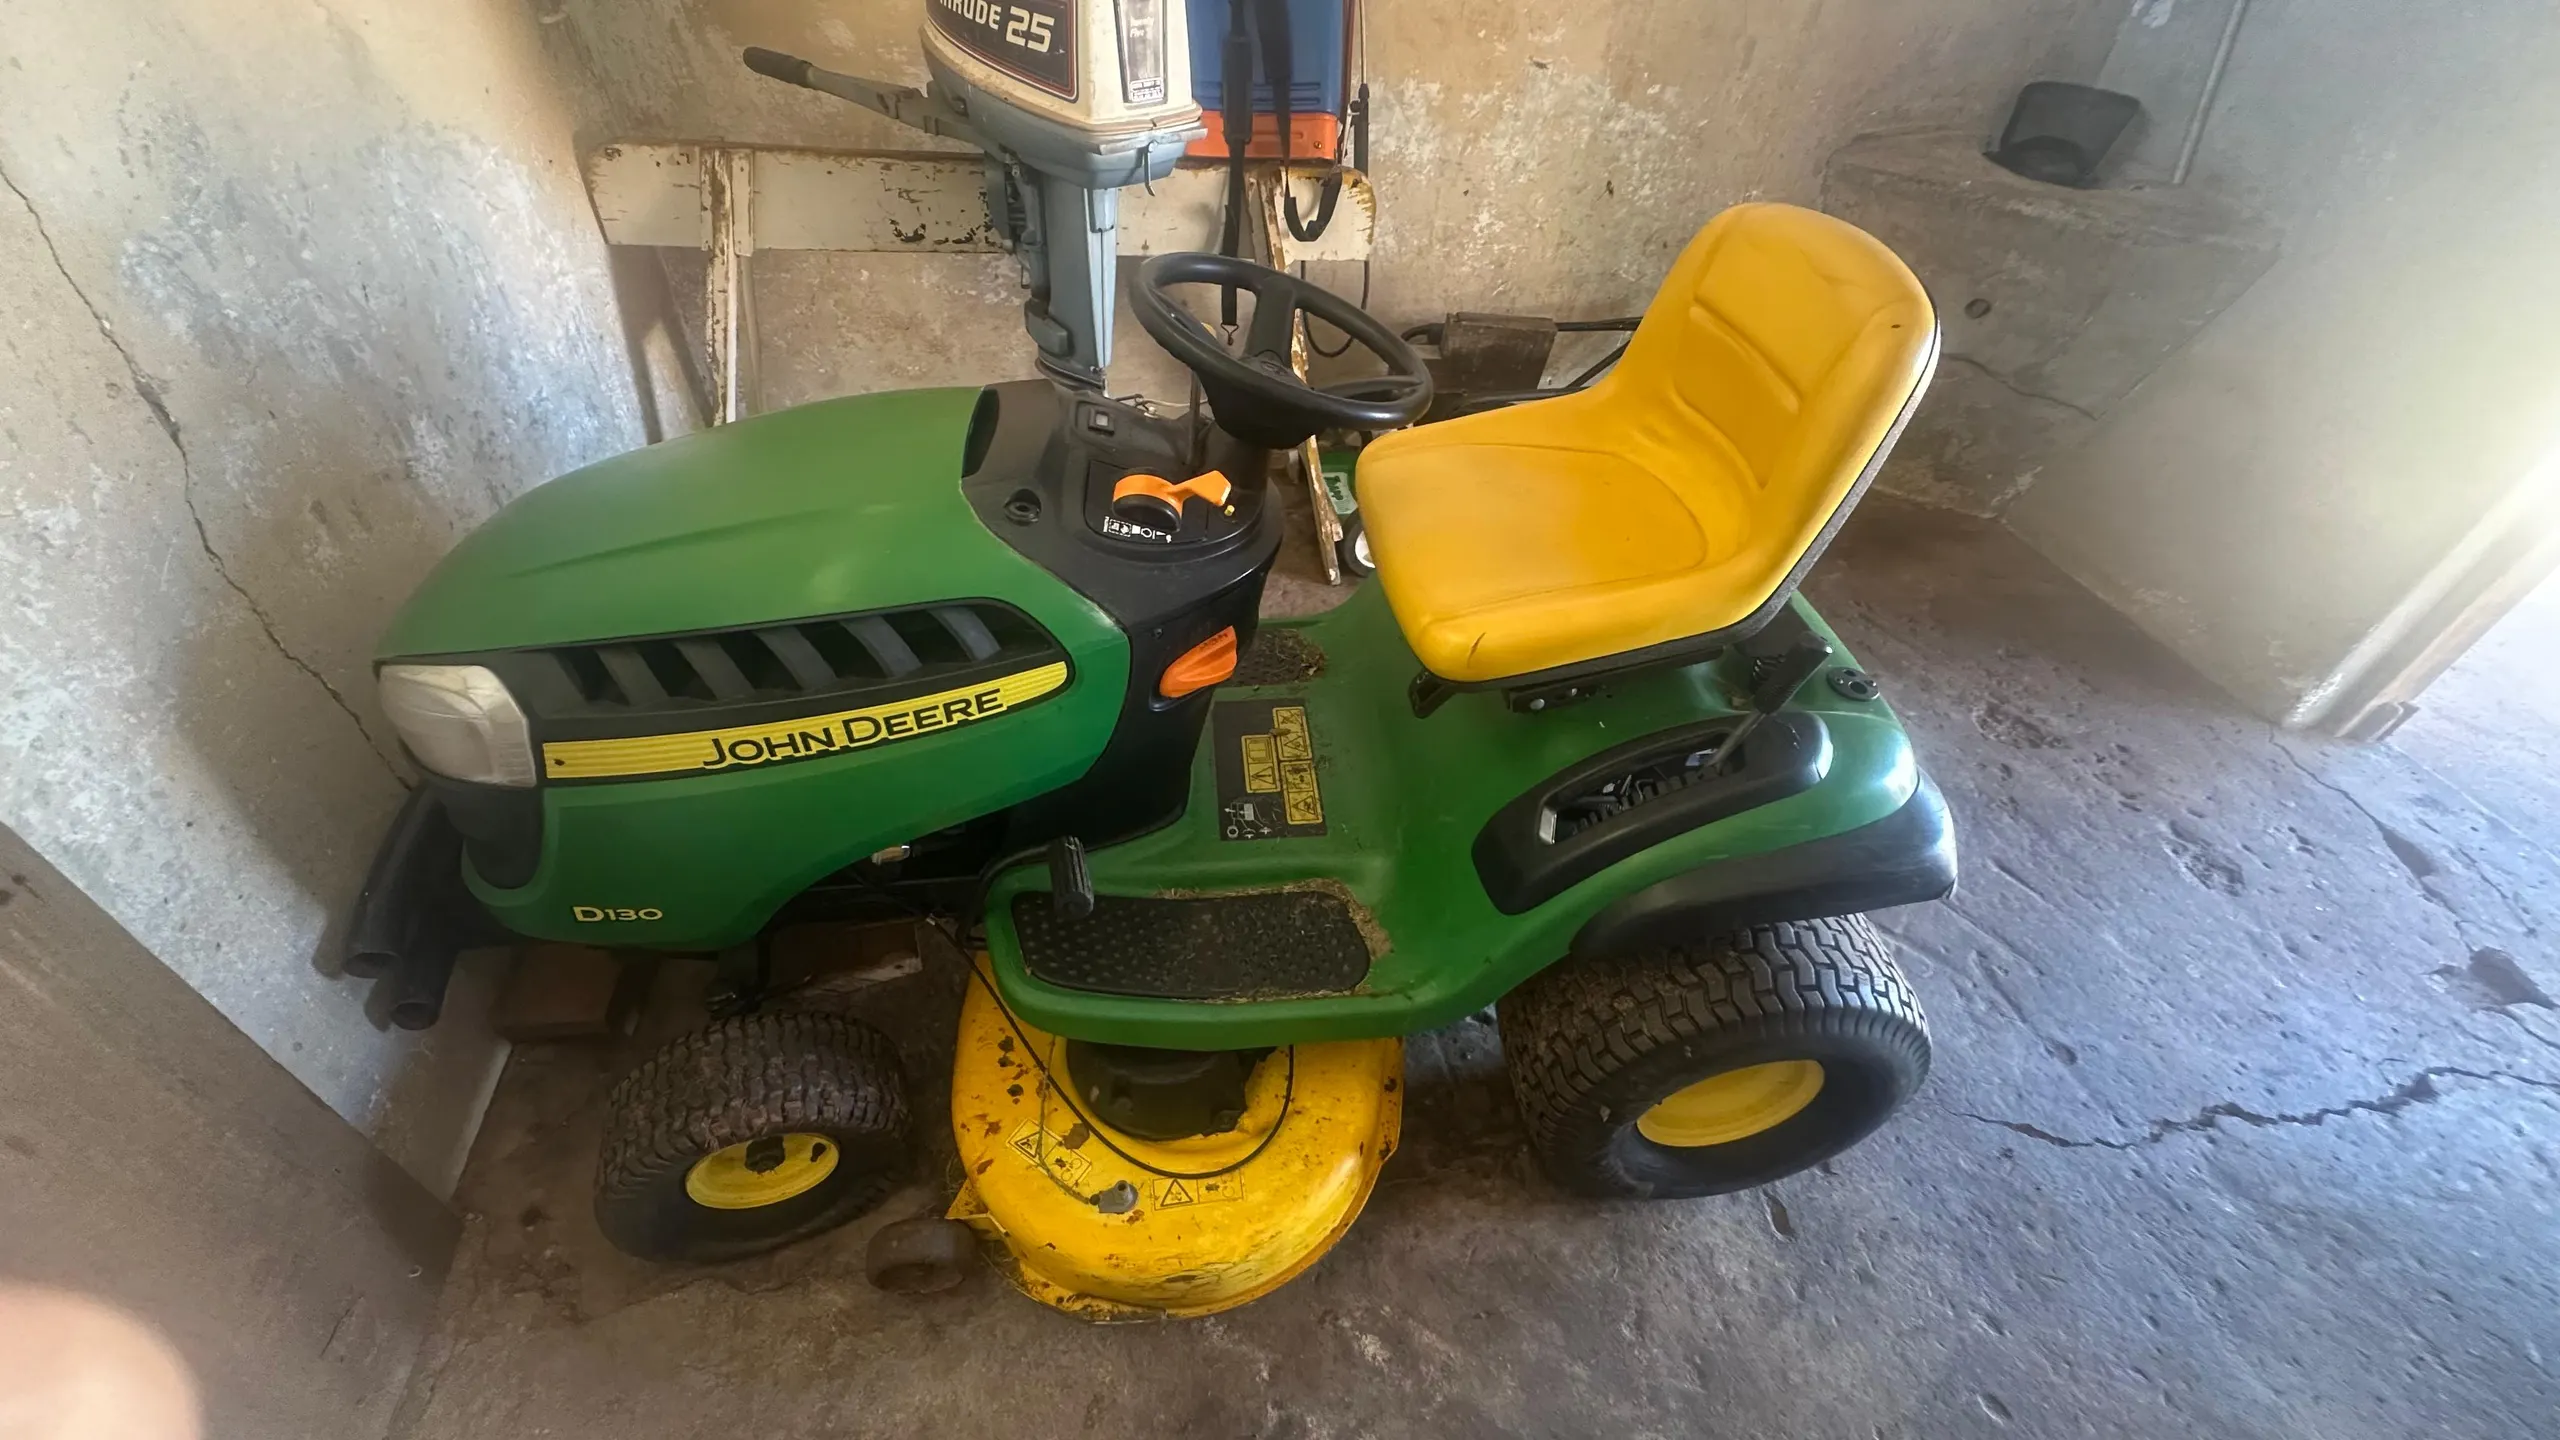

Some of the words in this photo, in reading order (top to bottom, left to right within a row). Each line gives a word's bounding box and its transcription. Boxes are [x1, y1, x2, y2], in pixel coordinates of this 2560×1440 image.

[1006, 6, 1055, 53] 25
[702, 727, 836, 767] JOHN
[842, 687, 1001, 745] DEERE
[572, 906, 663, 922] D130
